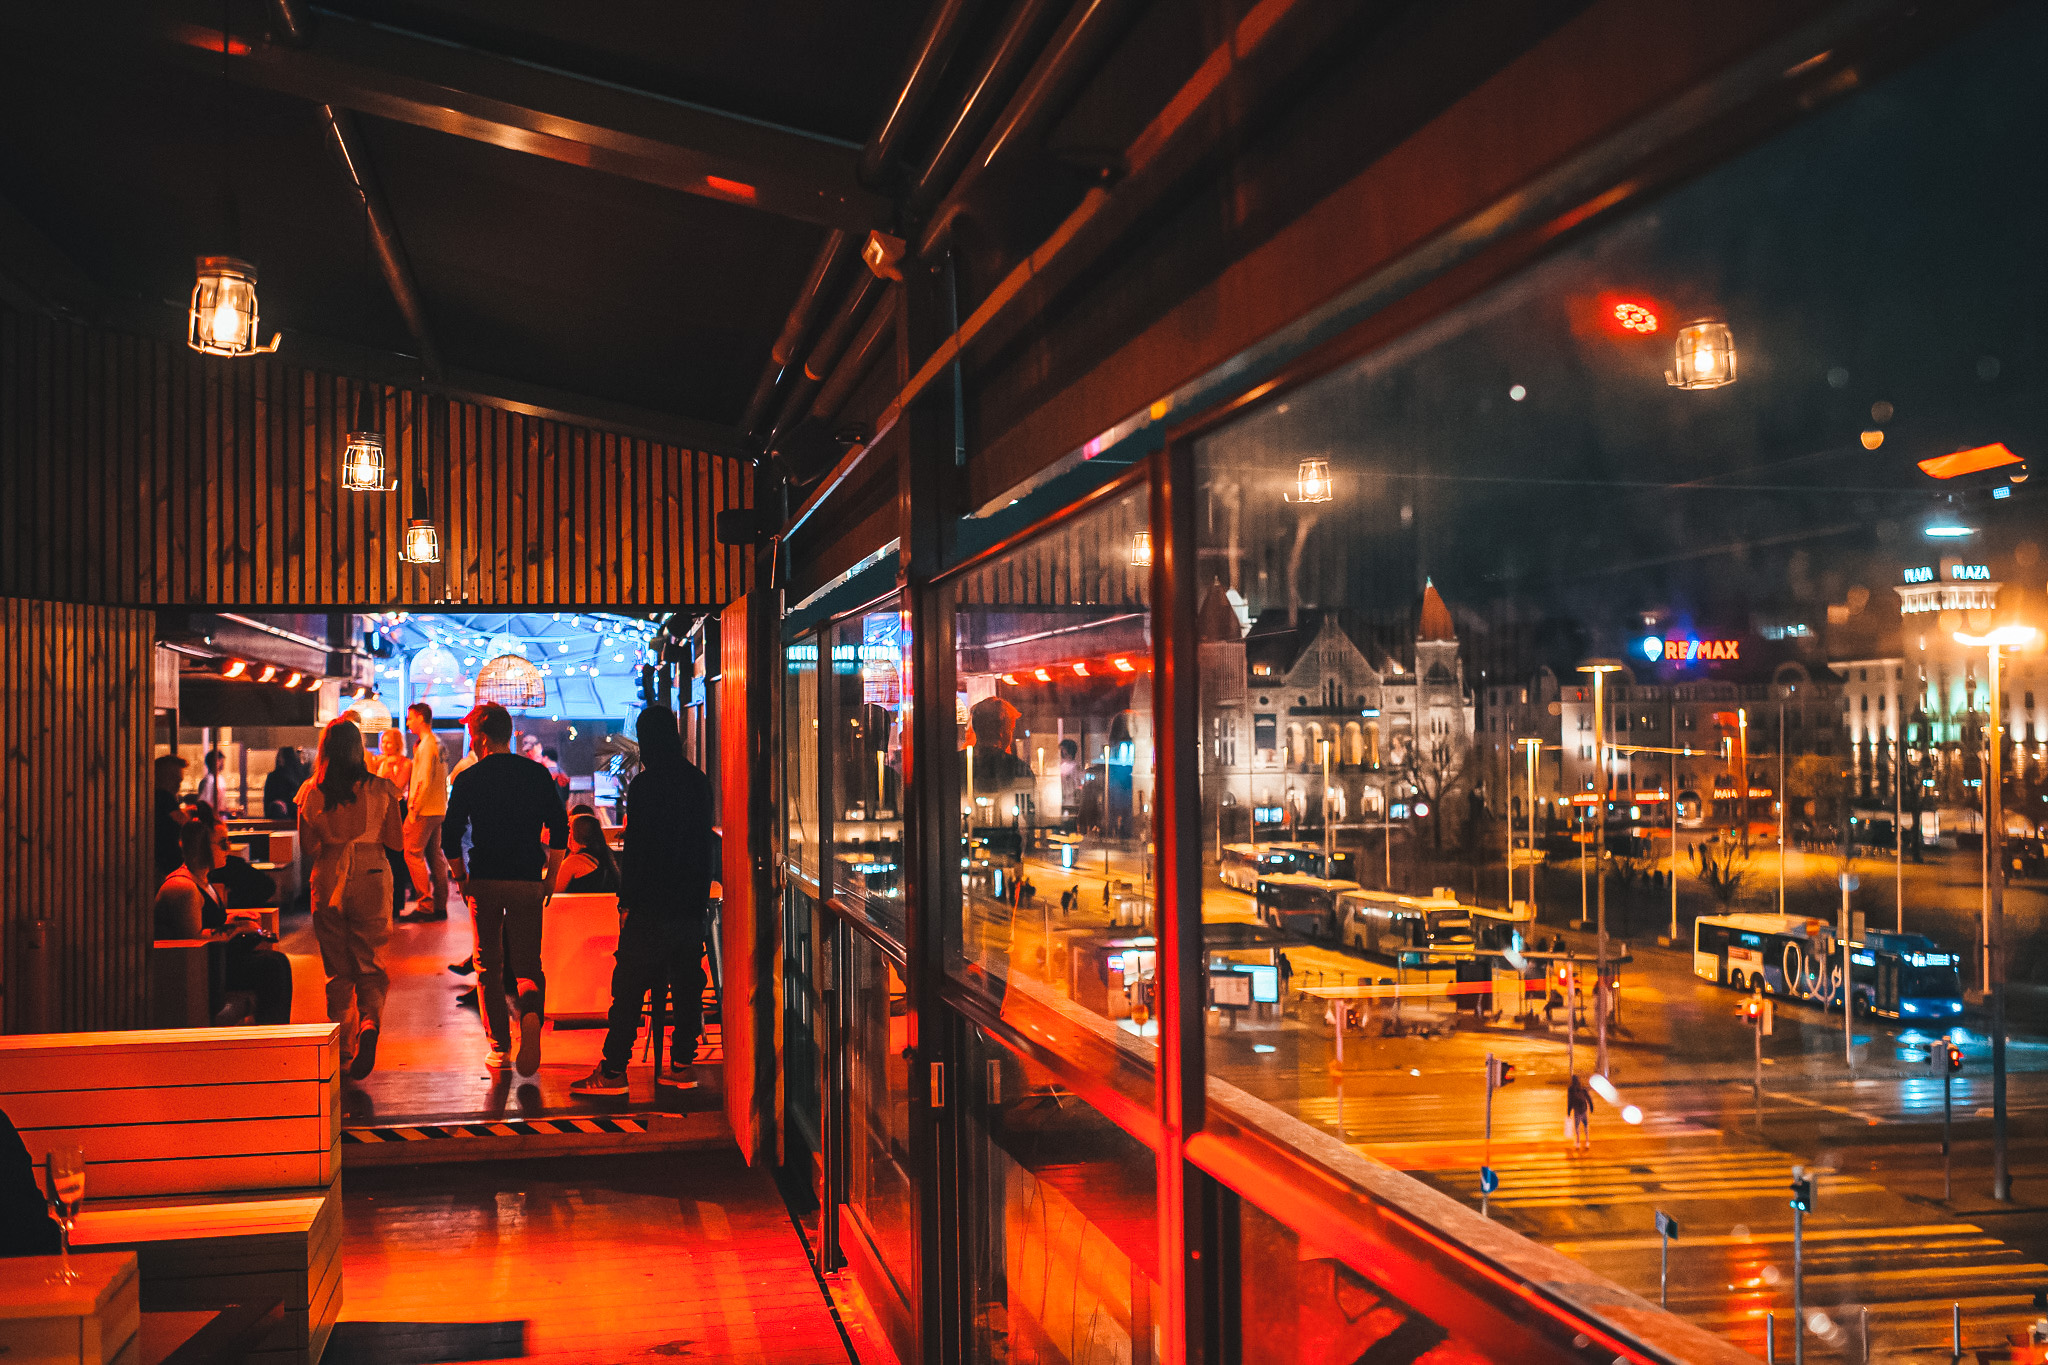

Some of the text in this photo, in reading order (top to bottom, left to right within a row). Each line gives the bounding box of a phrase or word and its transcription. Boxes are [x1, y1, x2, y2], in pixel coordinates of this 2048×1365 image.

[1904, 567, 1934, 583] PLAZA
[1951, 565, 1991, 580] PLAZA
[1664, 640, 1740, 660] RE/MAX
